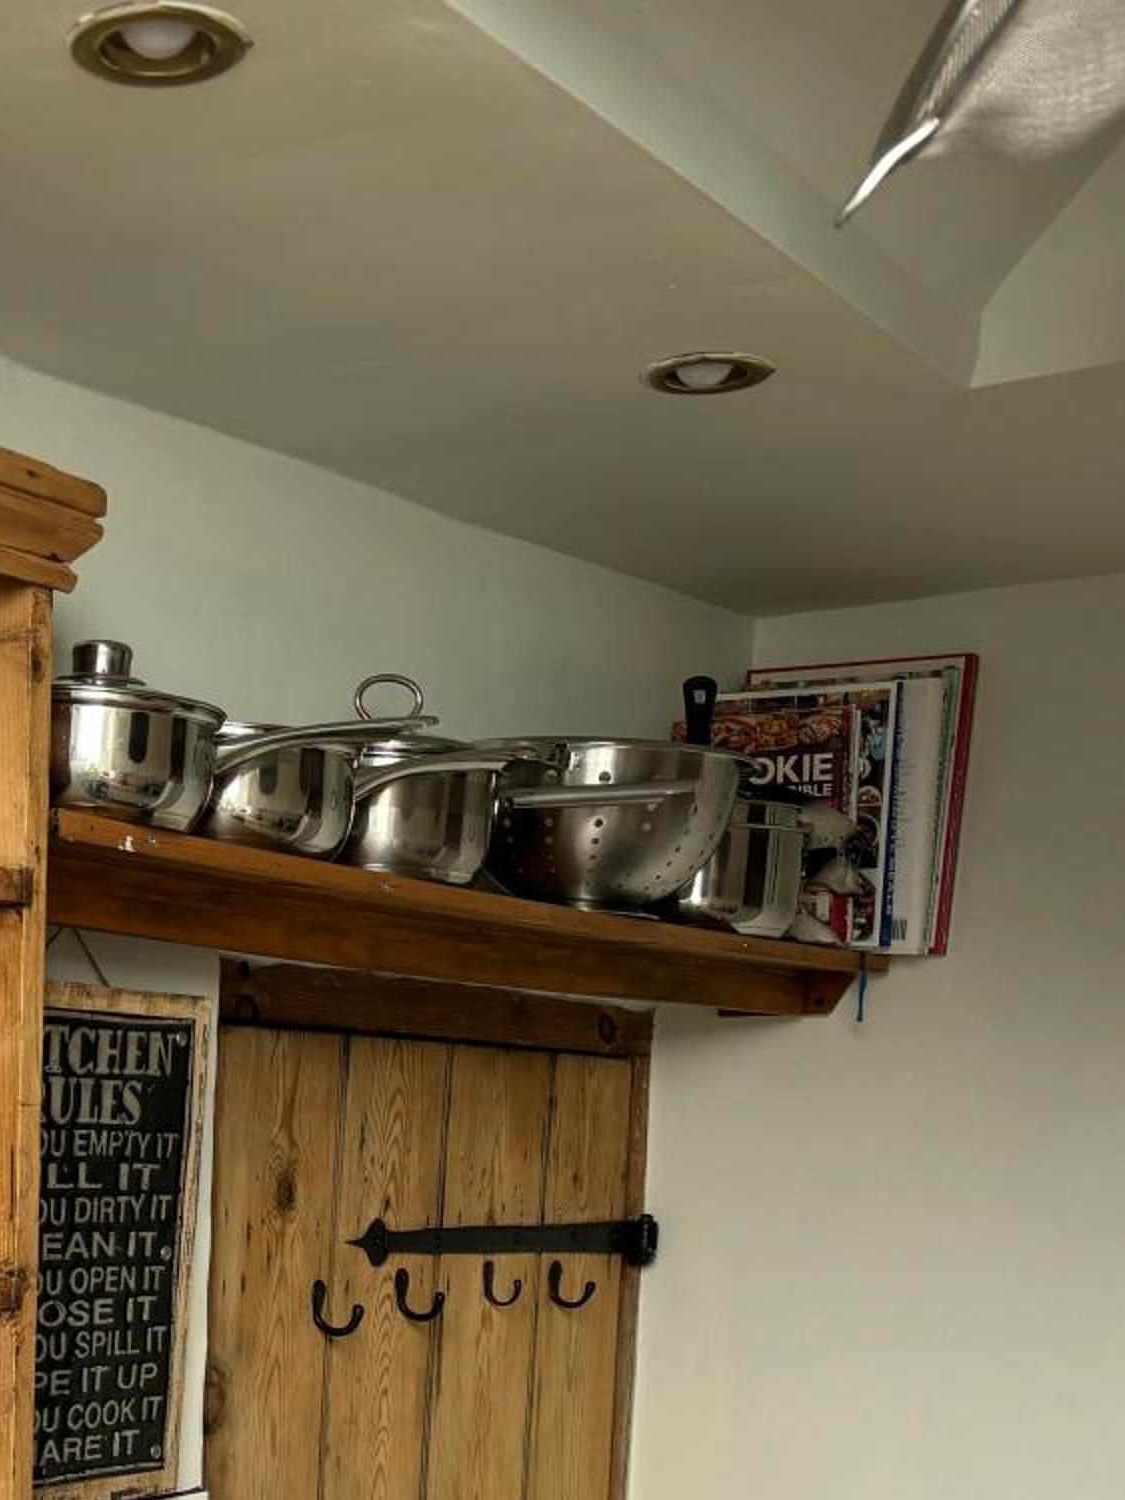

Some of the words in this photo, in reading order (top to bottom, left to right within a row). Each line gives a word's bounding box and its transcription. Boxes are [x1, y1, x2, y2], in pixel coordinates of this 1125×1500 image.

[748, 752, 834, 785] OKIE
[44, 1024, 177, 1077] TCHEN
[40, 1075, 143, 1126] ULES
[74, 1128, 152, 1159] EMPTY
[156, 1132, 180, 1160] IT
[118, 1162, 161, 1192] IT
[74, 1195, 146, 1224] DIRTY
[149, 1192, 174, 1223] IT
[41, 1231, 116, 1262] EAN
[69, 1265, 137, 1294] OPEN
[142, 1265, 167, 1291] IT
[38, 1298, 116, 1328] OSE
[125, 1295, 158, 1323] IT
[74, 1329, 140, 1359] SPILL
[145, 1324, 168, 1353] IT
[80, 1365, 111, 1394] IT
[116, 1361, 159, 1391] UP
[65, 1398, 137, 1431] COOK
[140, 1395, 164, 1422] IT
[38, 1434, 104, 1467] ARE
